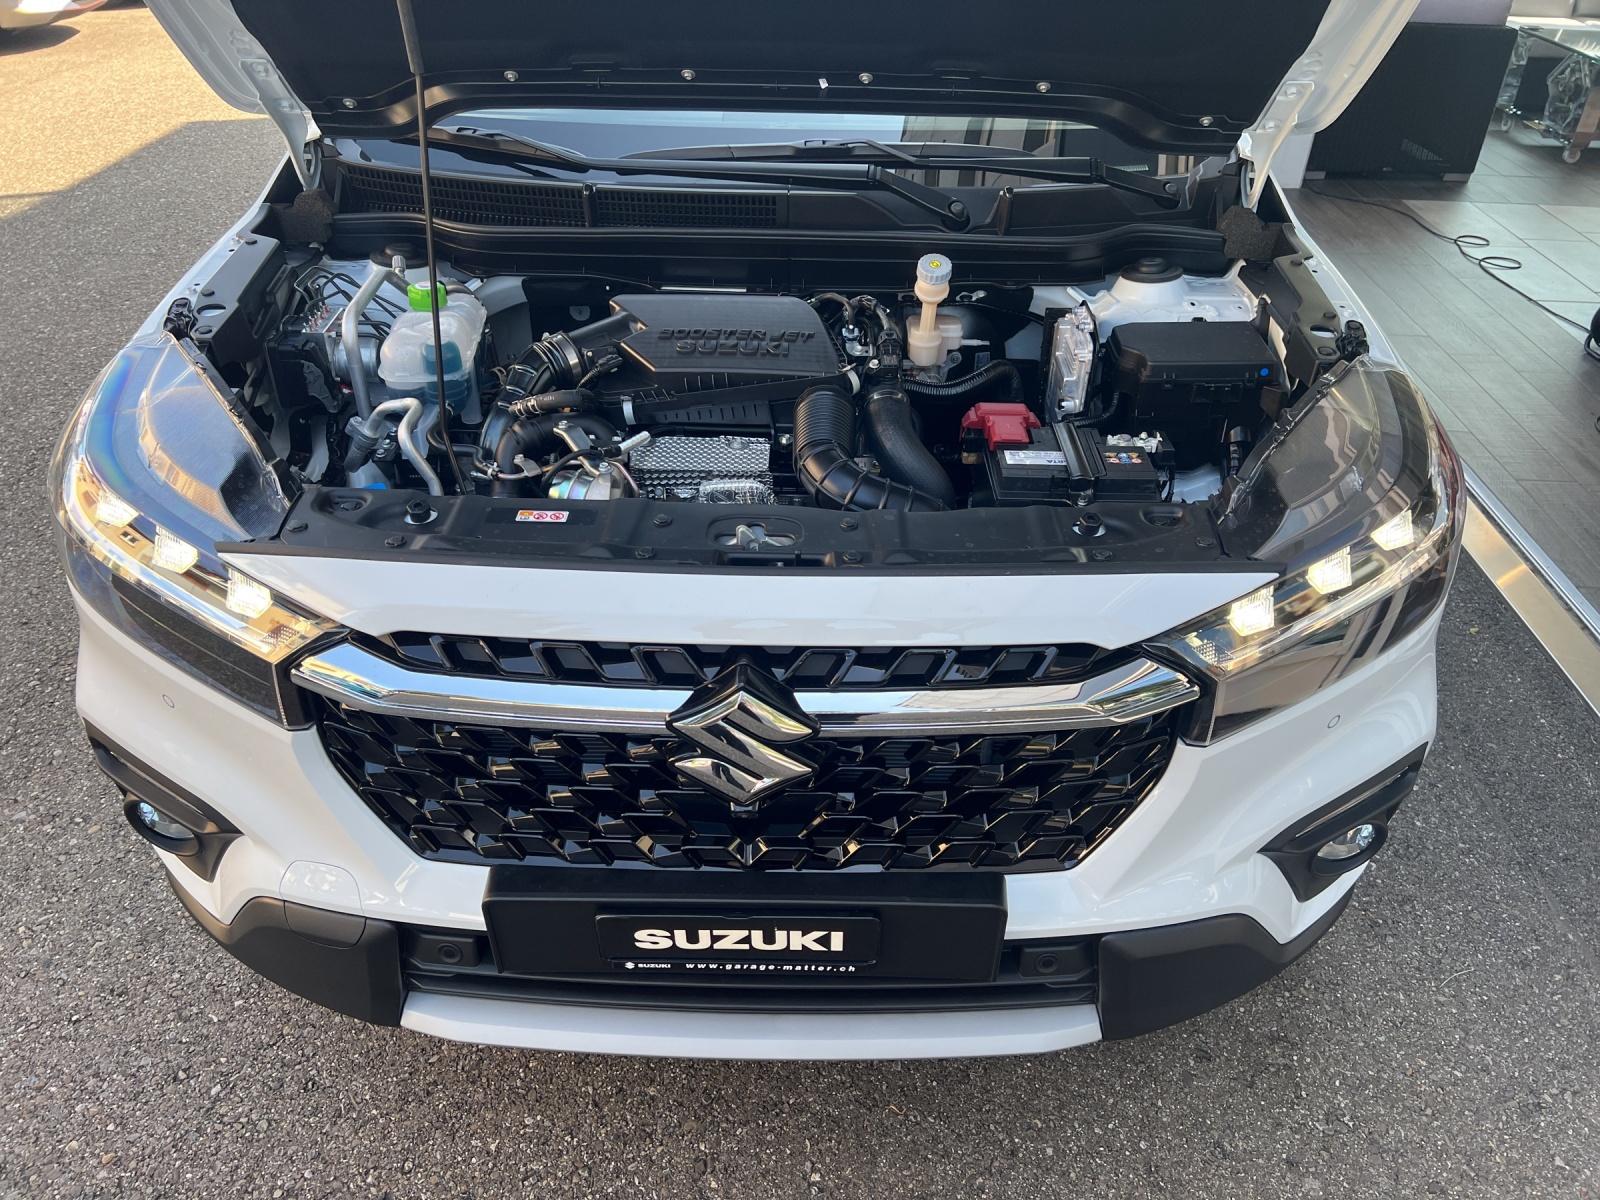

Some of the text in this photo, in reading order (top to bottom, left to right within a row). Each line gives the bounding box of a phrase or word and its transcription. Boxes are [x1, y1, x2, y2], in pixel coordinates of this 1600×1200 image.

[676, 339, 789, 356] SUZUKI
[633, 928, 844, 952] SUZUKI
[685, 963, 856, 972] www.garage-matter.ch
